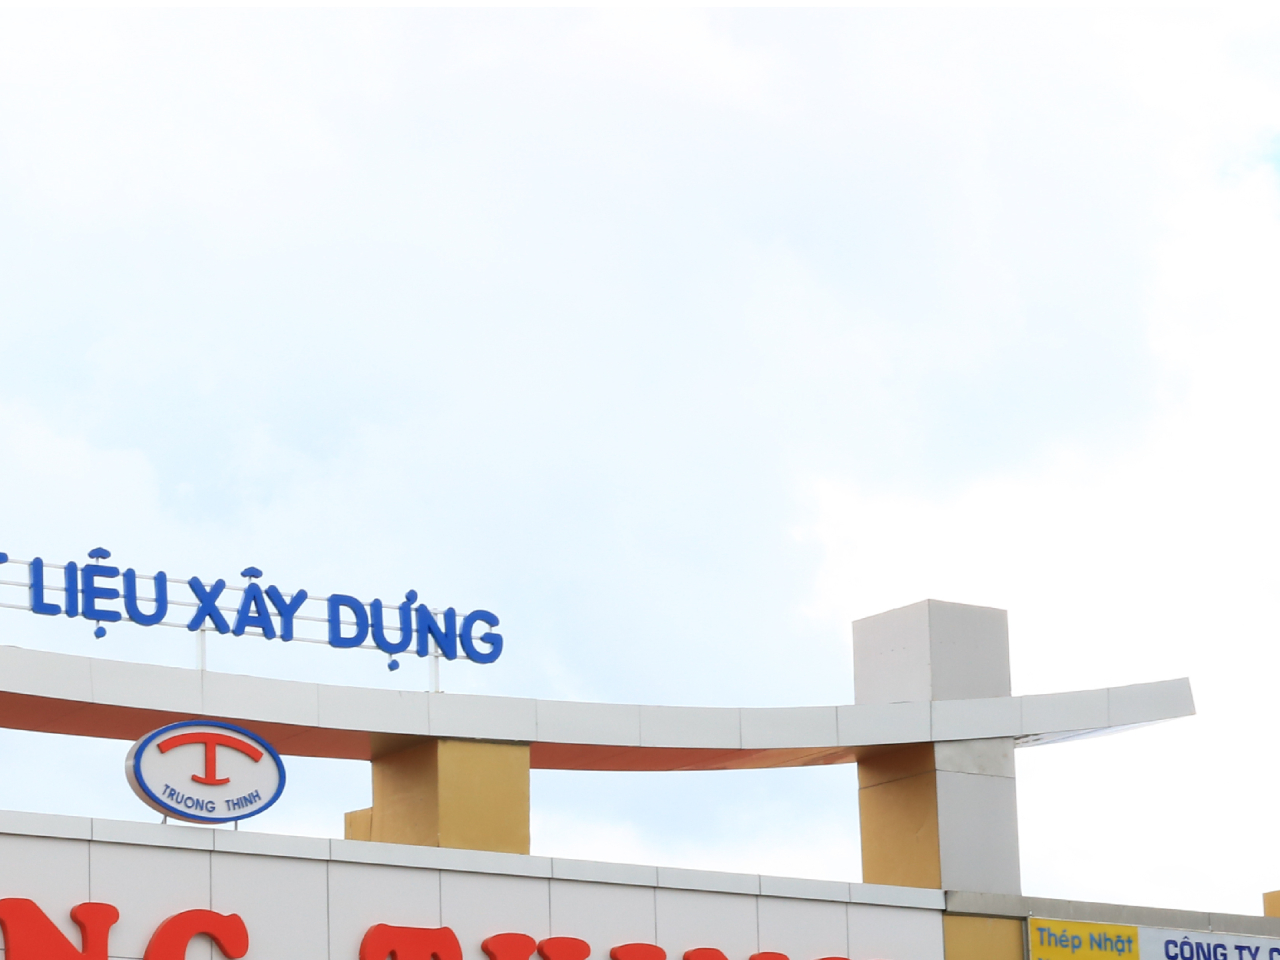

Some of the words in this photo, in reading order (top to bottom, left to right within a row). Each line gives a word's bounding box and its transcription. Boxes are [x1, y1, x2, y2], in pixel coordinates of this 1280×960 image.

[28, 546, 169, 639] LIỆU
[186, 566, 308, 642] XÂY
[327, 589, 504, 672] DỰNG
[162, 784, 216, 813] TRUONG
[225, 790, 261, 811] THINH
[1037, 927, 1082, 954] Thép
[1090, 932, 1133, 956] Nhật
